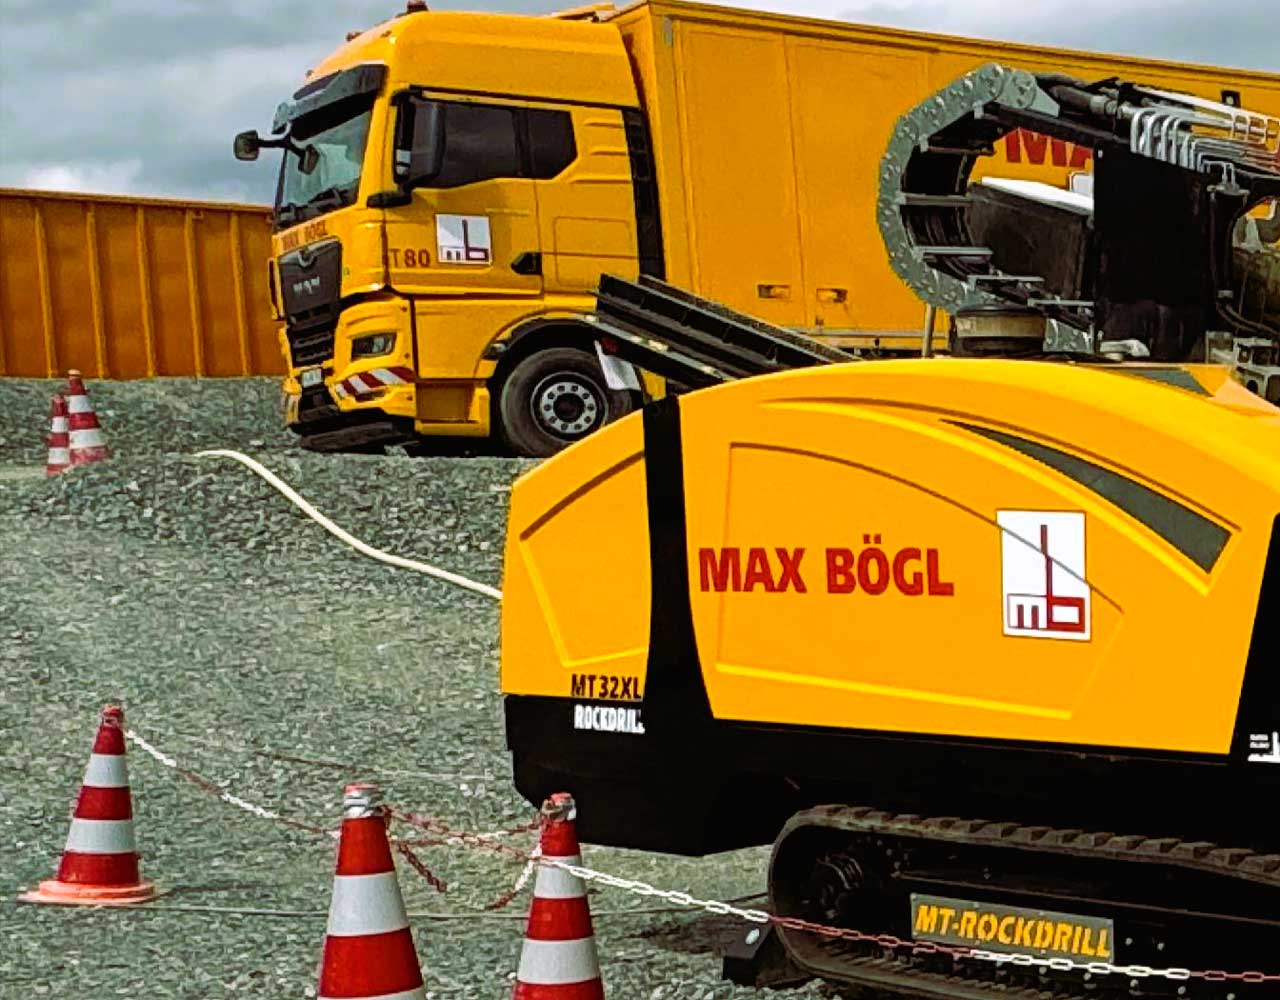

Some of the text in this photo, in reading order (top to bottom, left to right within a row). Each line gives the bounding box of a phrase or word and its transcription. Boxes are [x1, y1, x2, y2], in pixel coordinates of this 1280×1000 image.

[698, 533, 955, 597] MAX BÖGL
[915, 904, 1111, 959] MT-ROCKDRILL
